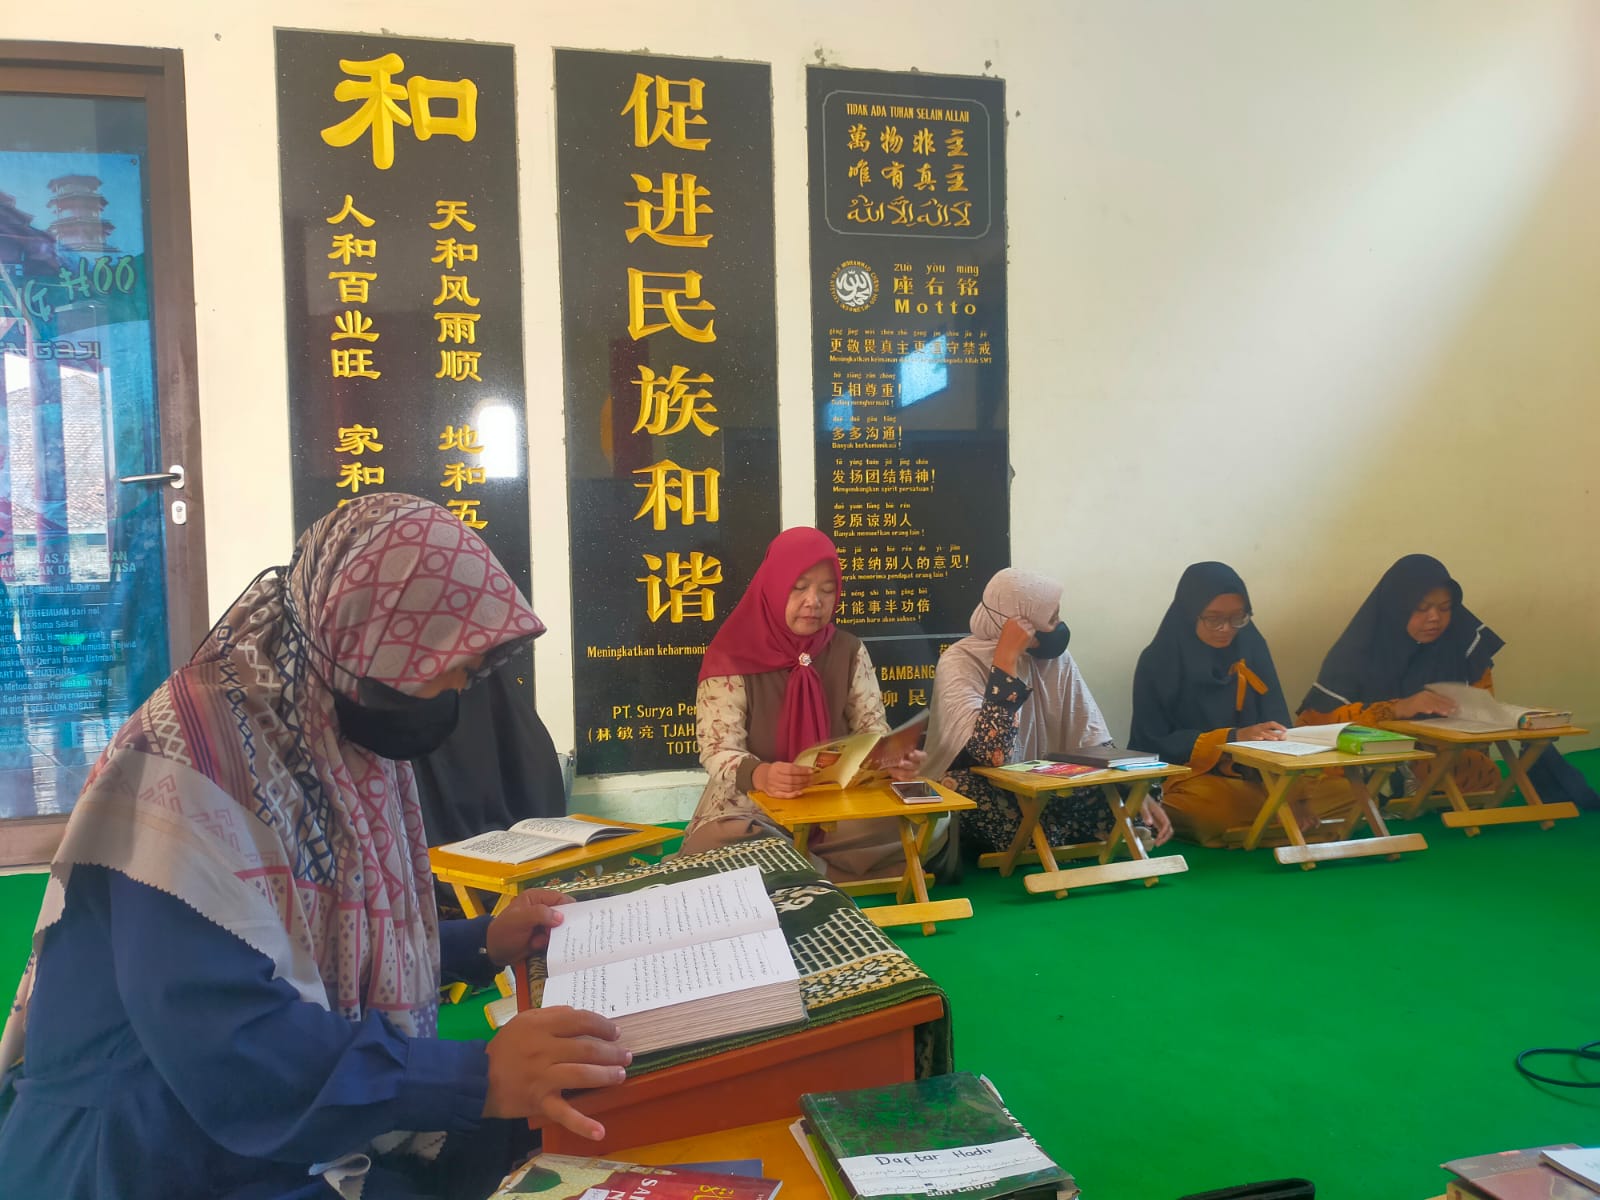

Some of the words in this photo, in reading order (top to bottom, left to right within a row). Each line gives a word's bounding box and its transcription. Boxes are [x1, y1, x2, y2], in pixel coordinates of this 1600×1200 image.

[320, 52, 478, 170] 和
[847, 103, 869, 117] TIDAK
[870, 105, 887, 117] ADA
[890, 106, 915, 118] TUHAN
[916, 108, 944, 121] SELAIN
[945, 111, 969, 122] ALLAH
[846, 122, 969, 157] 萬物非主
[848, 159, 968, 192] 唯有真主
[327, 195, 381, 380] 人和百业旺
[430, 200, 481, 381] 天和风雨顺
[893, 274, 979, 296] 座右铭
[894, 298, 976, 314] Motto
[621, 73, 723, 624] 促进民族和谐
[833, 512, 913, 529] 多原谅别人
[835, 598, 930, 615] 才能事半功倍
[587, 644, 655, 660] Meningkatkan
[881, 664, 935, 681] BAMBANG
[612, 702, 634, 720] PT.
[636, 702, 674, 722] Surya
[874, 1153, 940, 1166] Daftar
[952, 1147, 994, 1159] Hadir
